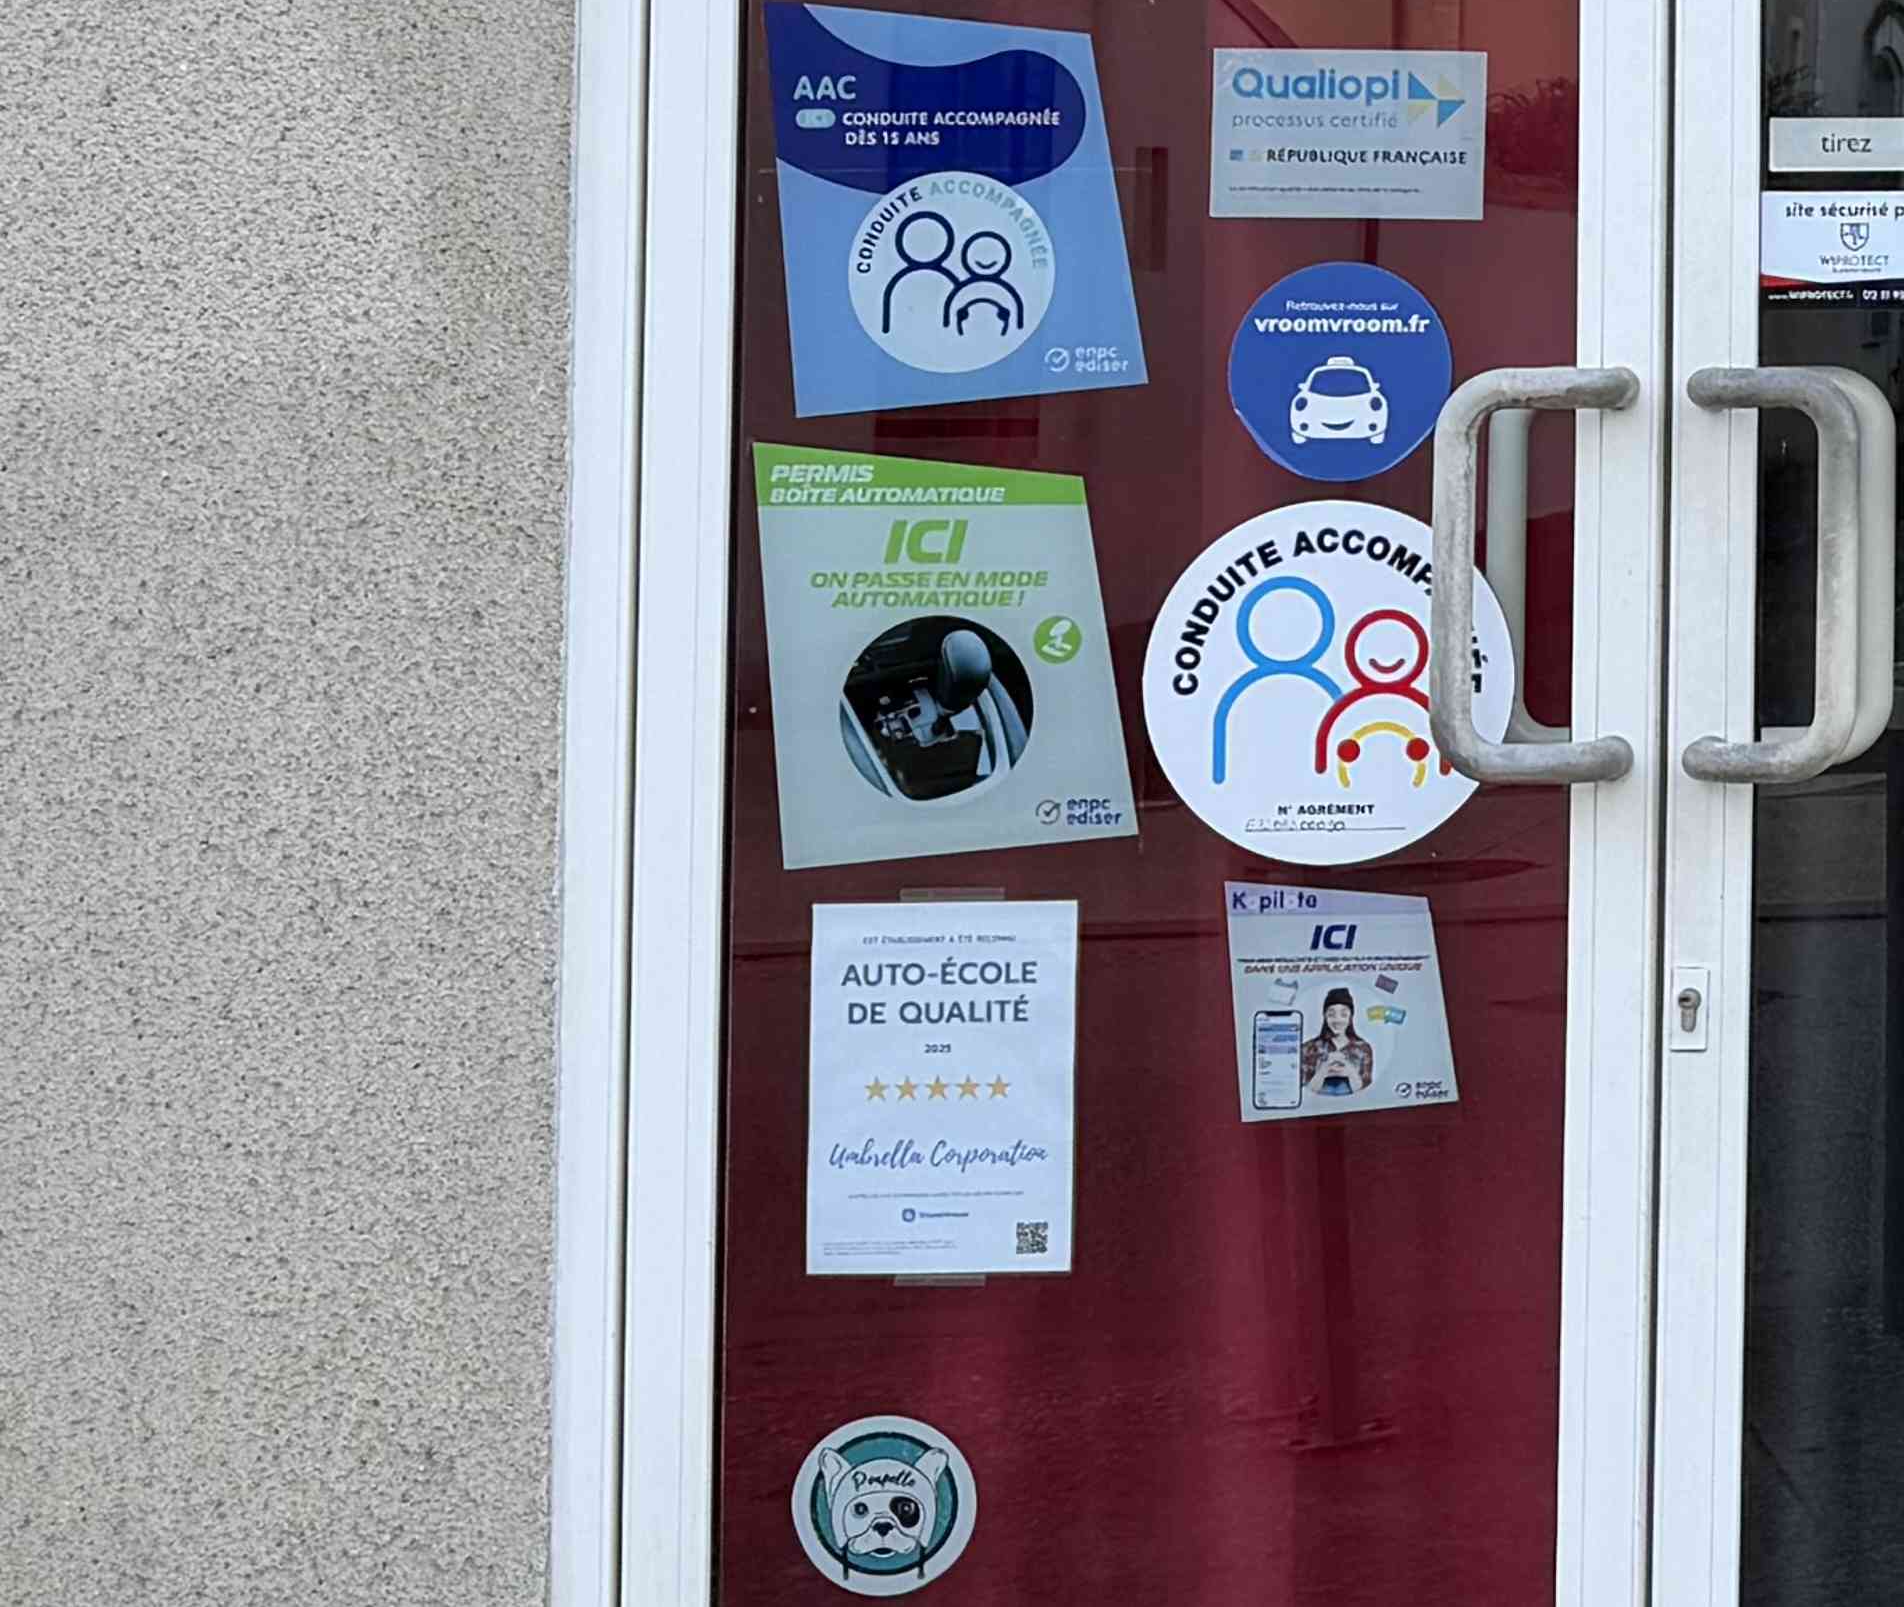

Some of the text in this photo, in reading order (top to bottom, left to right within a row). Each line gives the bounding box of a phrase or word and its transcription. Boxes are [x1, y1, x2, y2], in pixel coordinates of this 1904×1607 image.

[793, 75, 857, 100] AAC
[1232, 67, 1400, 106] Qualiopi
[843, 108, 1061, 127] CONDUITE ACCOMPAGNÉE
[1232, 113, 1398, 129] processus certifié
[846, 131, 877, 145] DÈS
[904, 131, 940, 145] ANS
[1822, 134, 1872, 153] tirez
[1266, 146, 1468, 166] RÉPUBLIQUE FRANÇAISE
[1786, 203, 1814, 217] site
[1820, 202, 1888, 217] sécurisé
[856, 179, 1048, 275] CONDUITE ACCOMPAGNÉE
[1380, 303, 1399, 311] sur
[1254, 314, 1430, 333] vroomvroom.fr
[770, 464, 874, 482] PERMIS
[770, 485, 1005, 504] BOÎTE AUTOMATIQUE
[883, 519, 968, 565] ICI
[809, 571, 1048, 588] ON PASSE EN MODE
[831, 591, 1014, 609] AUTOMATIQUE
[1172, 539, 1283, 696] CONDUITE
[1066, 796, 1111, 813] enpc
[1066, 810, 1122, 826] ediser
[1310, 924, 1357, 950] ICI
[841, 956, 1038, 986] AUTO-ÉCOLE
[848, 995, 1030, 1025] DE QUALITÉ
[829, 1138, 1048, 1172] Umbrella Corporation
